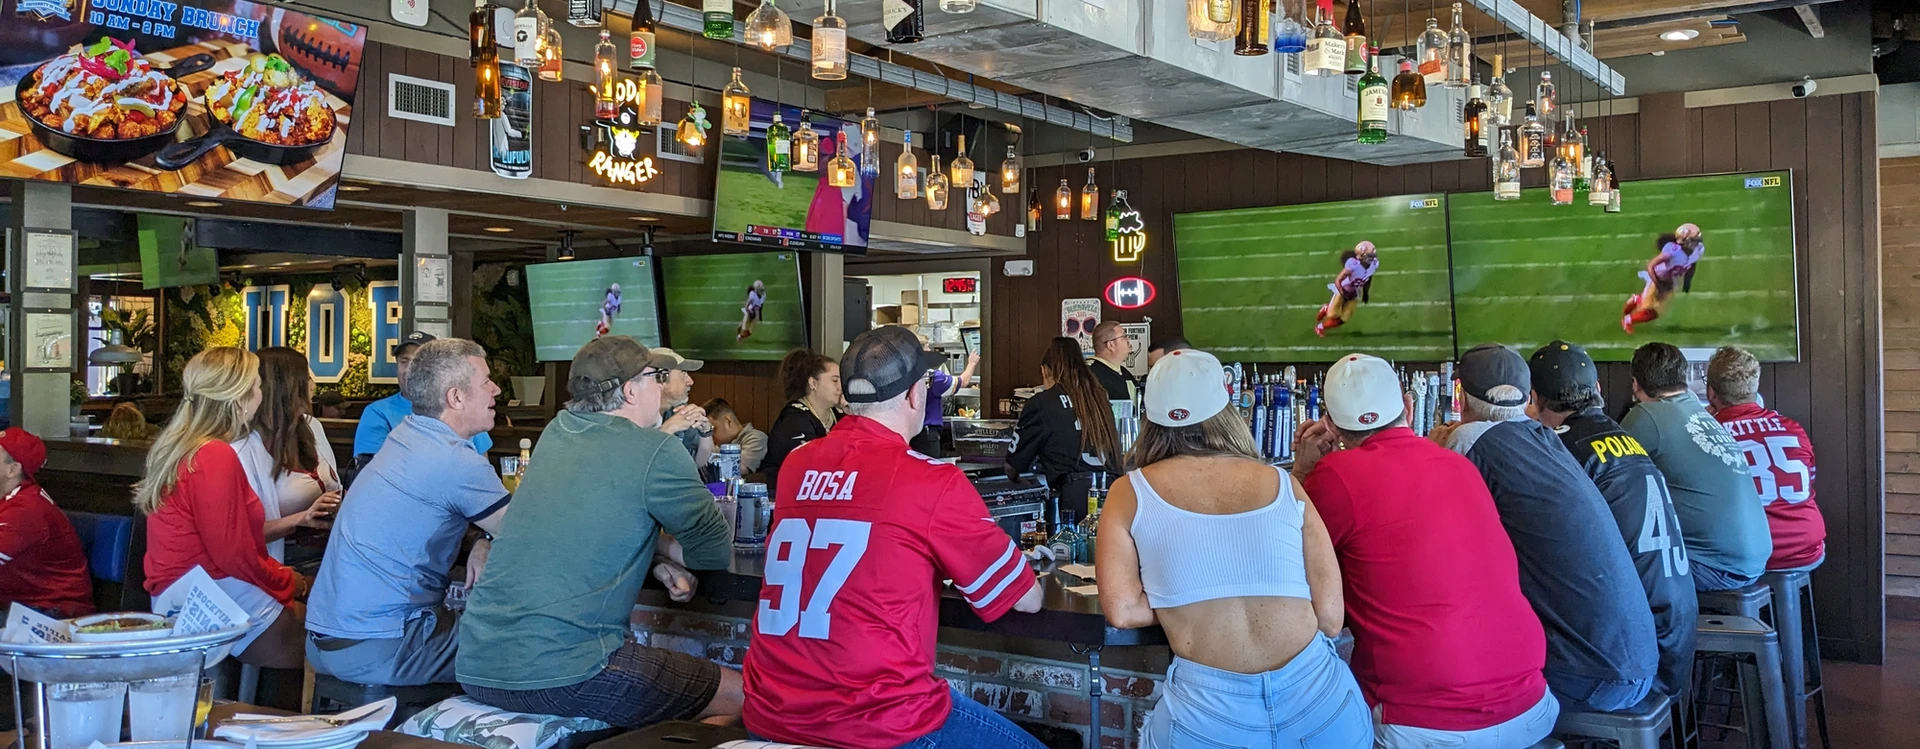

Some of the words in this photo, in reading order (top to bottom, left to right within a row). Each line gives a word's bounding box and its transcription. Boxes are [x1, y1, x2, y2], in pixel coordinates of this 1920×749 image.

[89, 11, 104, 25] 10
[106, 14, 130, 30] AM
[142, 22, 151, 34] 2
[153, 24, 176, 38] PM
[181, 6, 260, 38] BRUNCH
[1331, 48, 1345, 56] Mark
[589, 151, 659, 185] RANGER
[1745, 178, 1763, 188] FOX
[1764, 178, 1780, 186] NFL
[1424, 199, 1437, 207] NFL
[1723, 417, 1786, 437] KITTLE
[797, 470, 859, 501] BOSA
[1736, 436, 1811, 507] 85
[758, 518, 872, 640] 97
